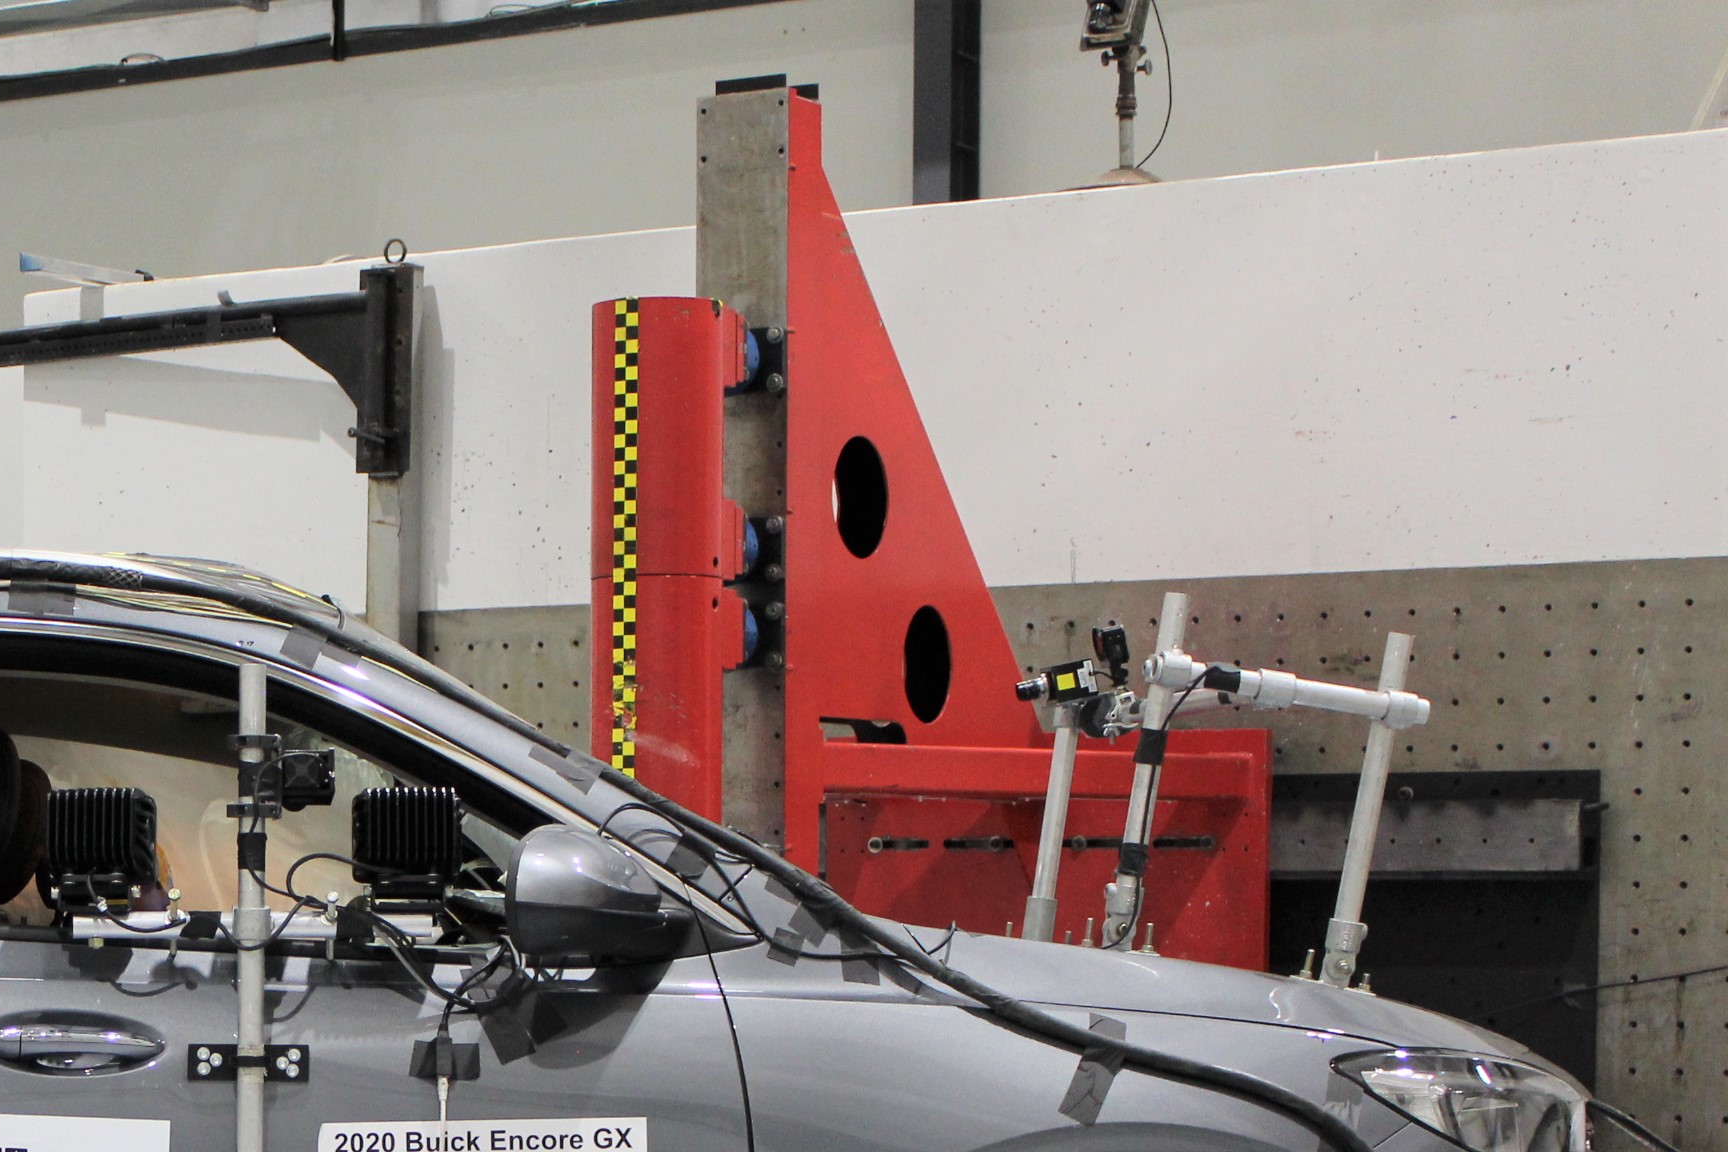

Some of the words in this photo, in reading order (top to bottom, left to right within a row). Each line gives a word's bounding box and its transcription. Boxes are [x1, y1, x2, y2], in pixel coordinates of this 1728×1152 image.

[405, 1131, 480, 1152] Buick
[490, 1129, 584, 1151] Encore
[593, 1127, 633, 1149] GX
